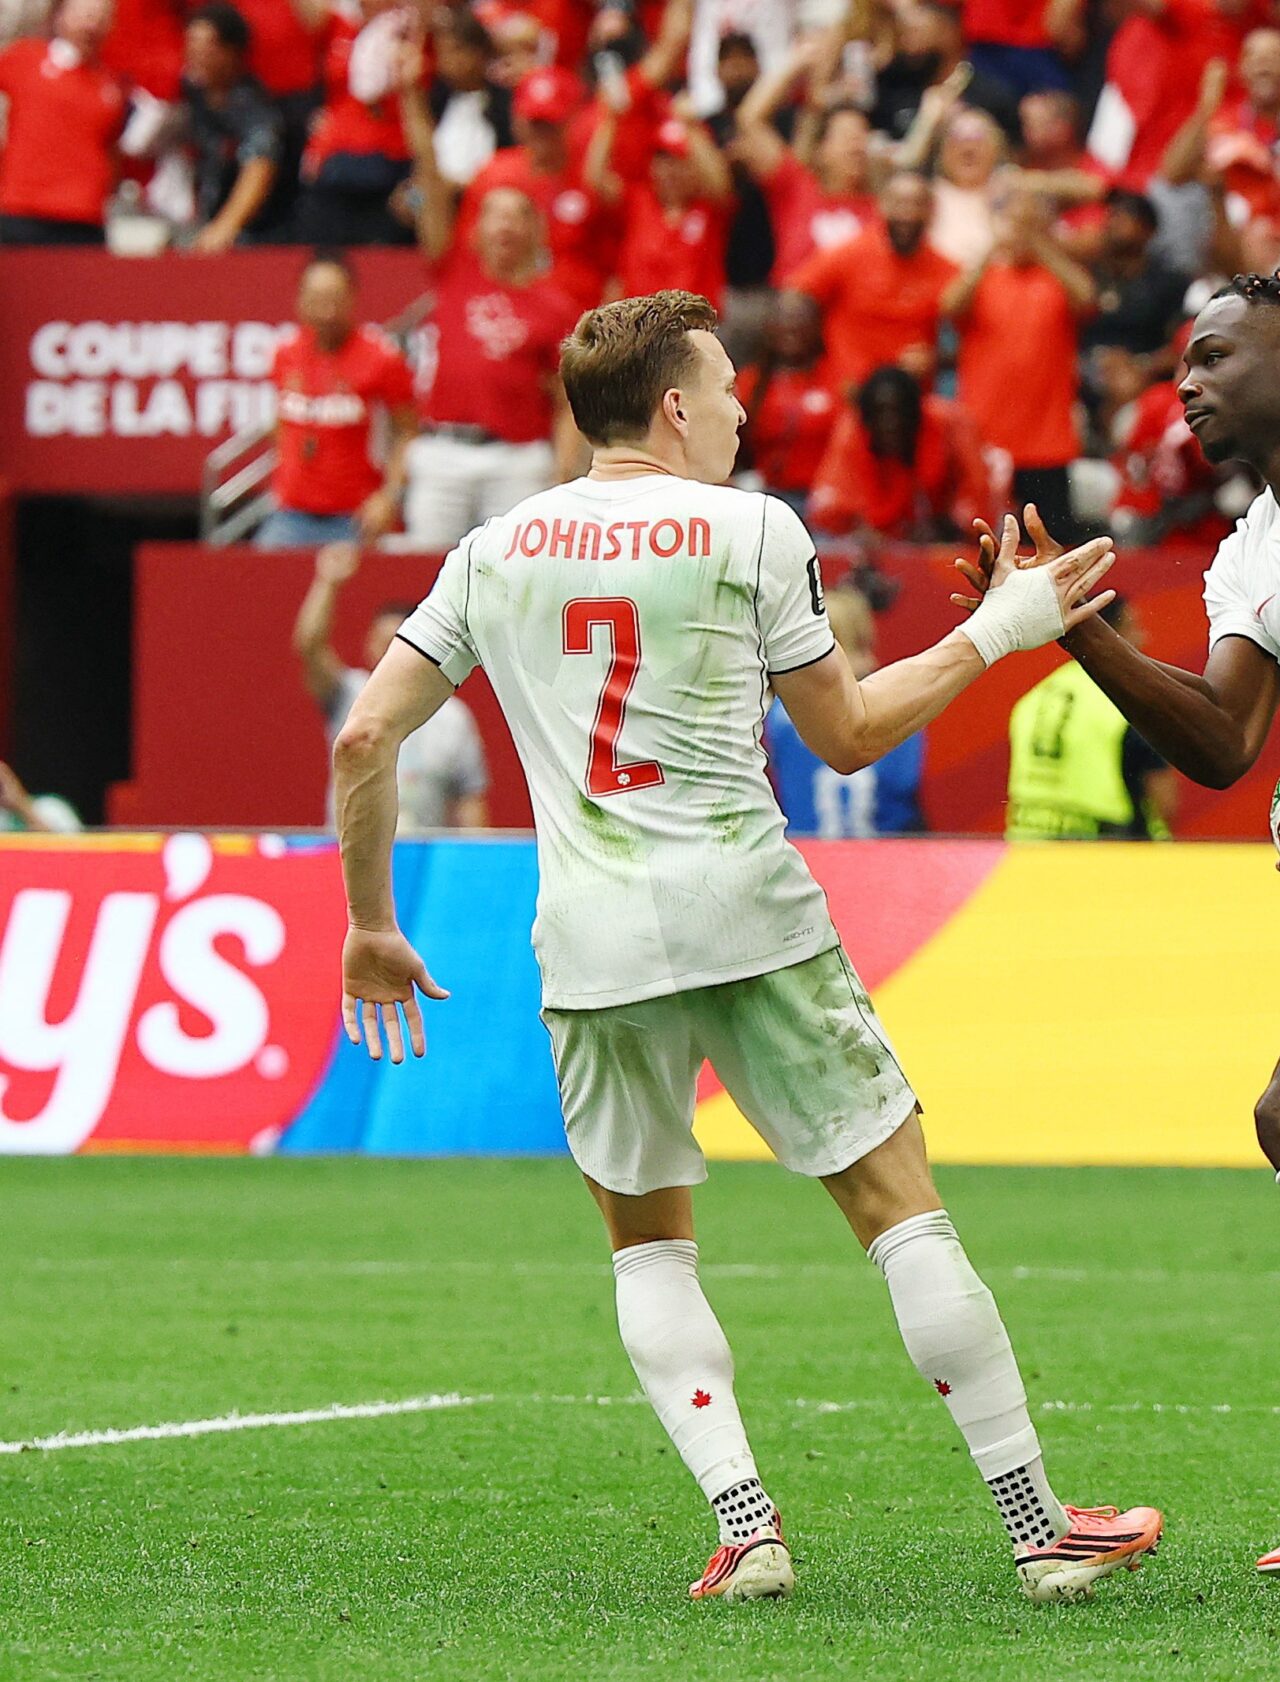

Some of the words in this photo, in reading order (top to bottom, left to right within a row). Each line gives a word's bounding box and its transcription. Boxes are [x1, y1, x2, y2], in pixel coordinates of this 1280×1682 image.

[30, 321, 229, 377] COUPE
[232, 321, 299, 377] D
[25, 380, 106, 437] DE
[111, 380, 193, 437] LA
[504, 517, 711, 560] JOHNSTON
[562, 596, 665, 797] 2
